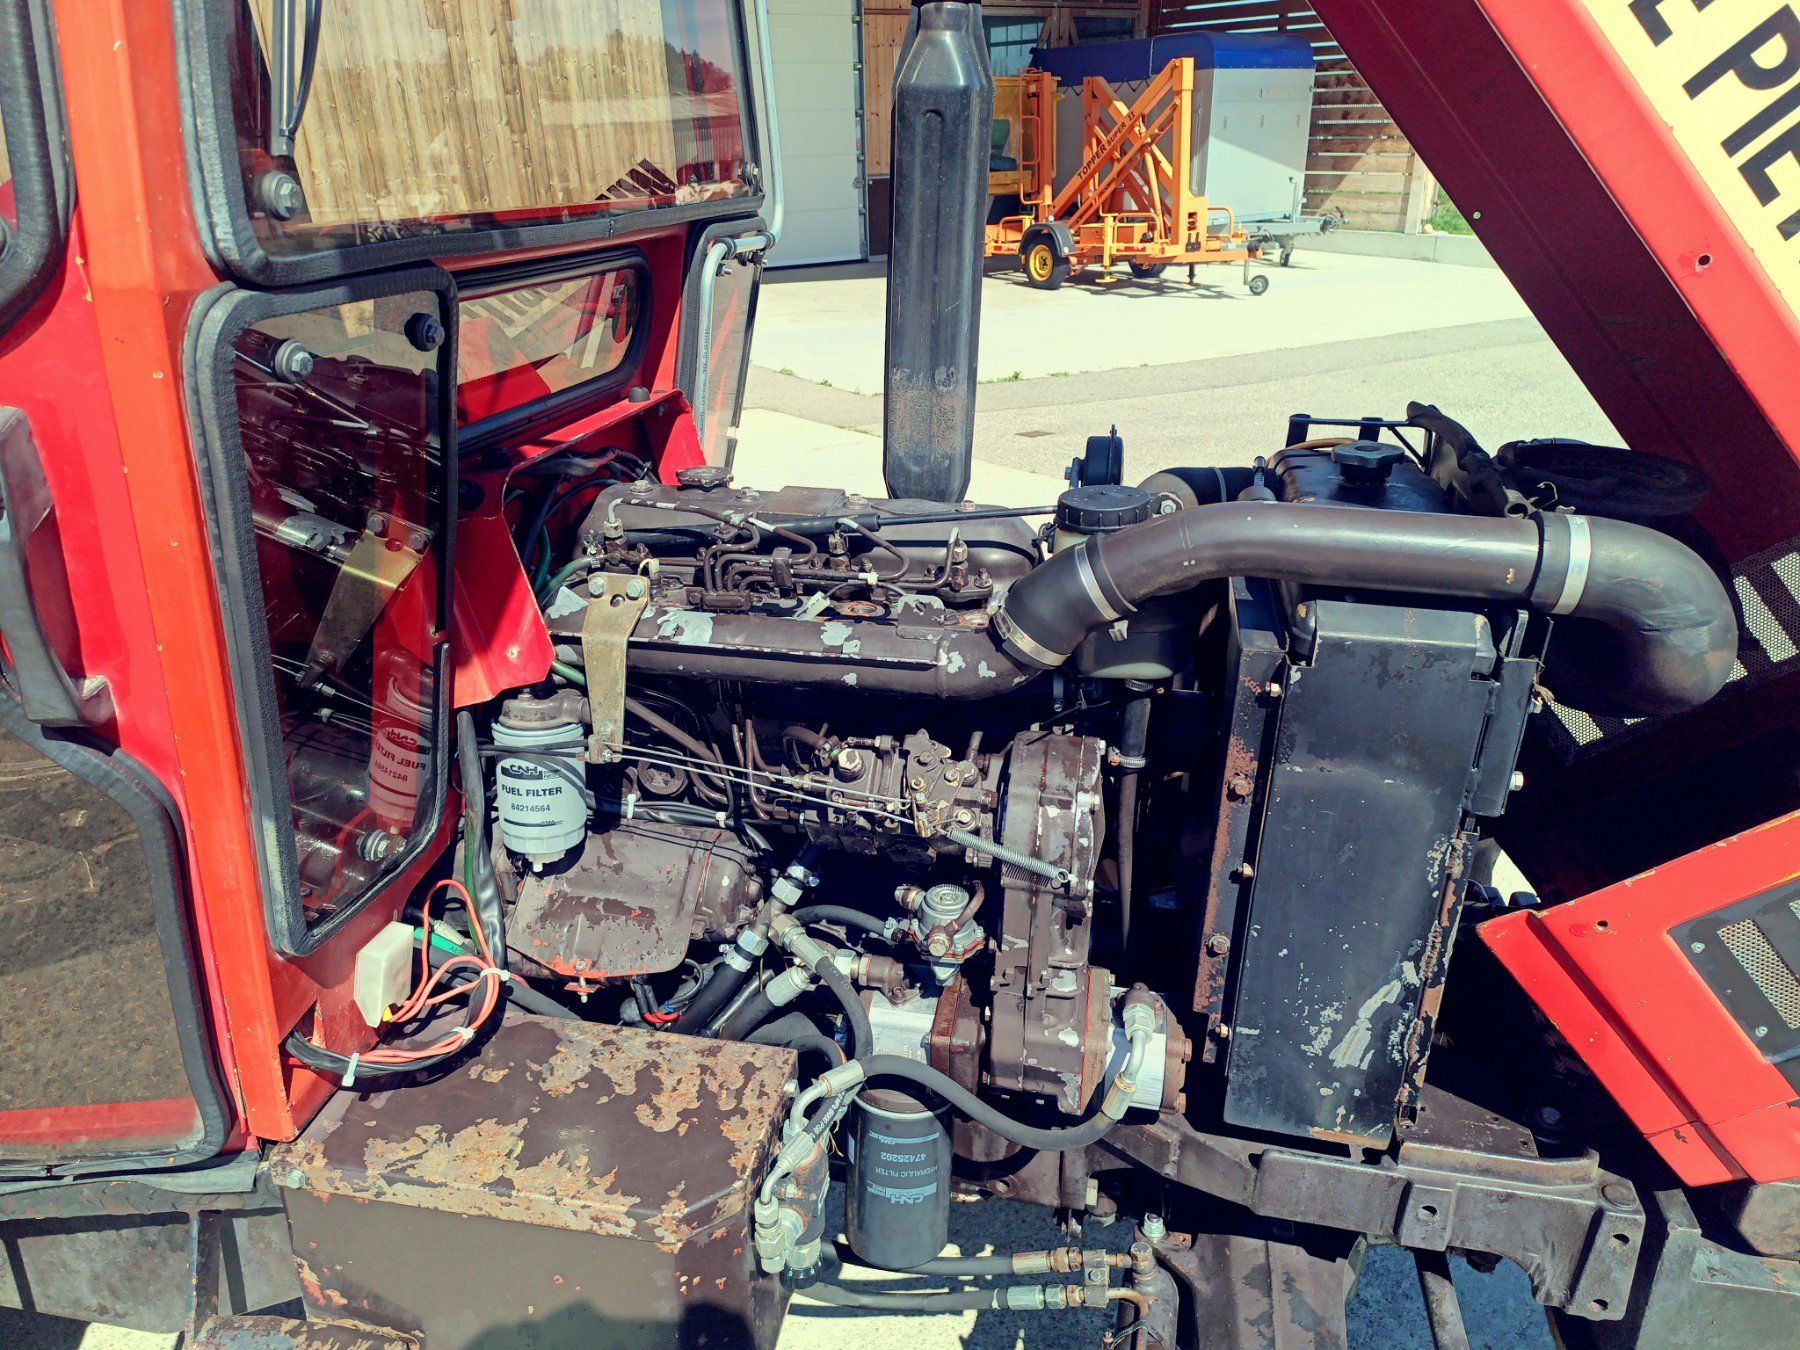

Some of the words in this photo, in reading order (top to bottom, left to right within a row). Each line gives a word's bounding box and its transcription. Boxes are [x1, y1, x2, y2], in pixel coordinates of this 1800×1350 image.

[1078, 144, 1107, 180] TOPPER
[1107, 121, 1127, 147] SUPER
[509, 764, 538, 775] CNH
[501, 784, 522, 797] FUEL
[526, 786, 562, 797] FILTER
[511, 803, 551, 813] 84214564
[880, 1152, 927, 1163] 47425202
[875, 1166, 899, 1177] FILTER
[900, 1166, 938, 1178] HYDRAULIC
[890, 1194, 924, 1205] CNH
